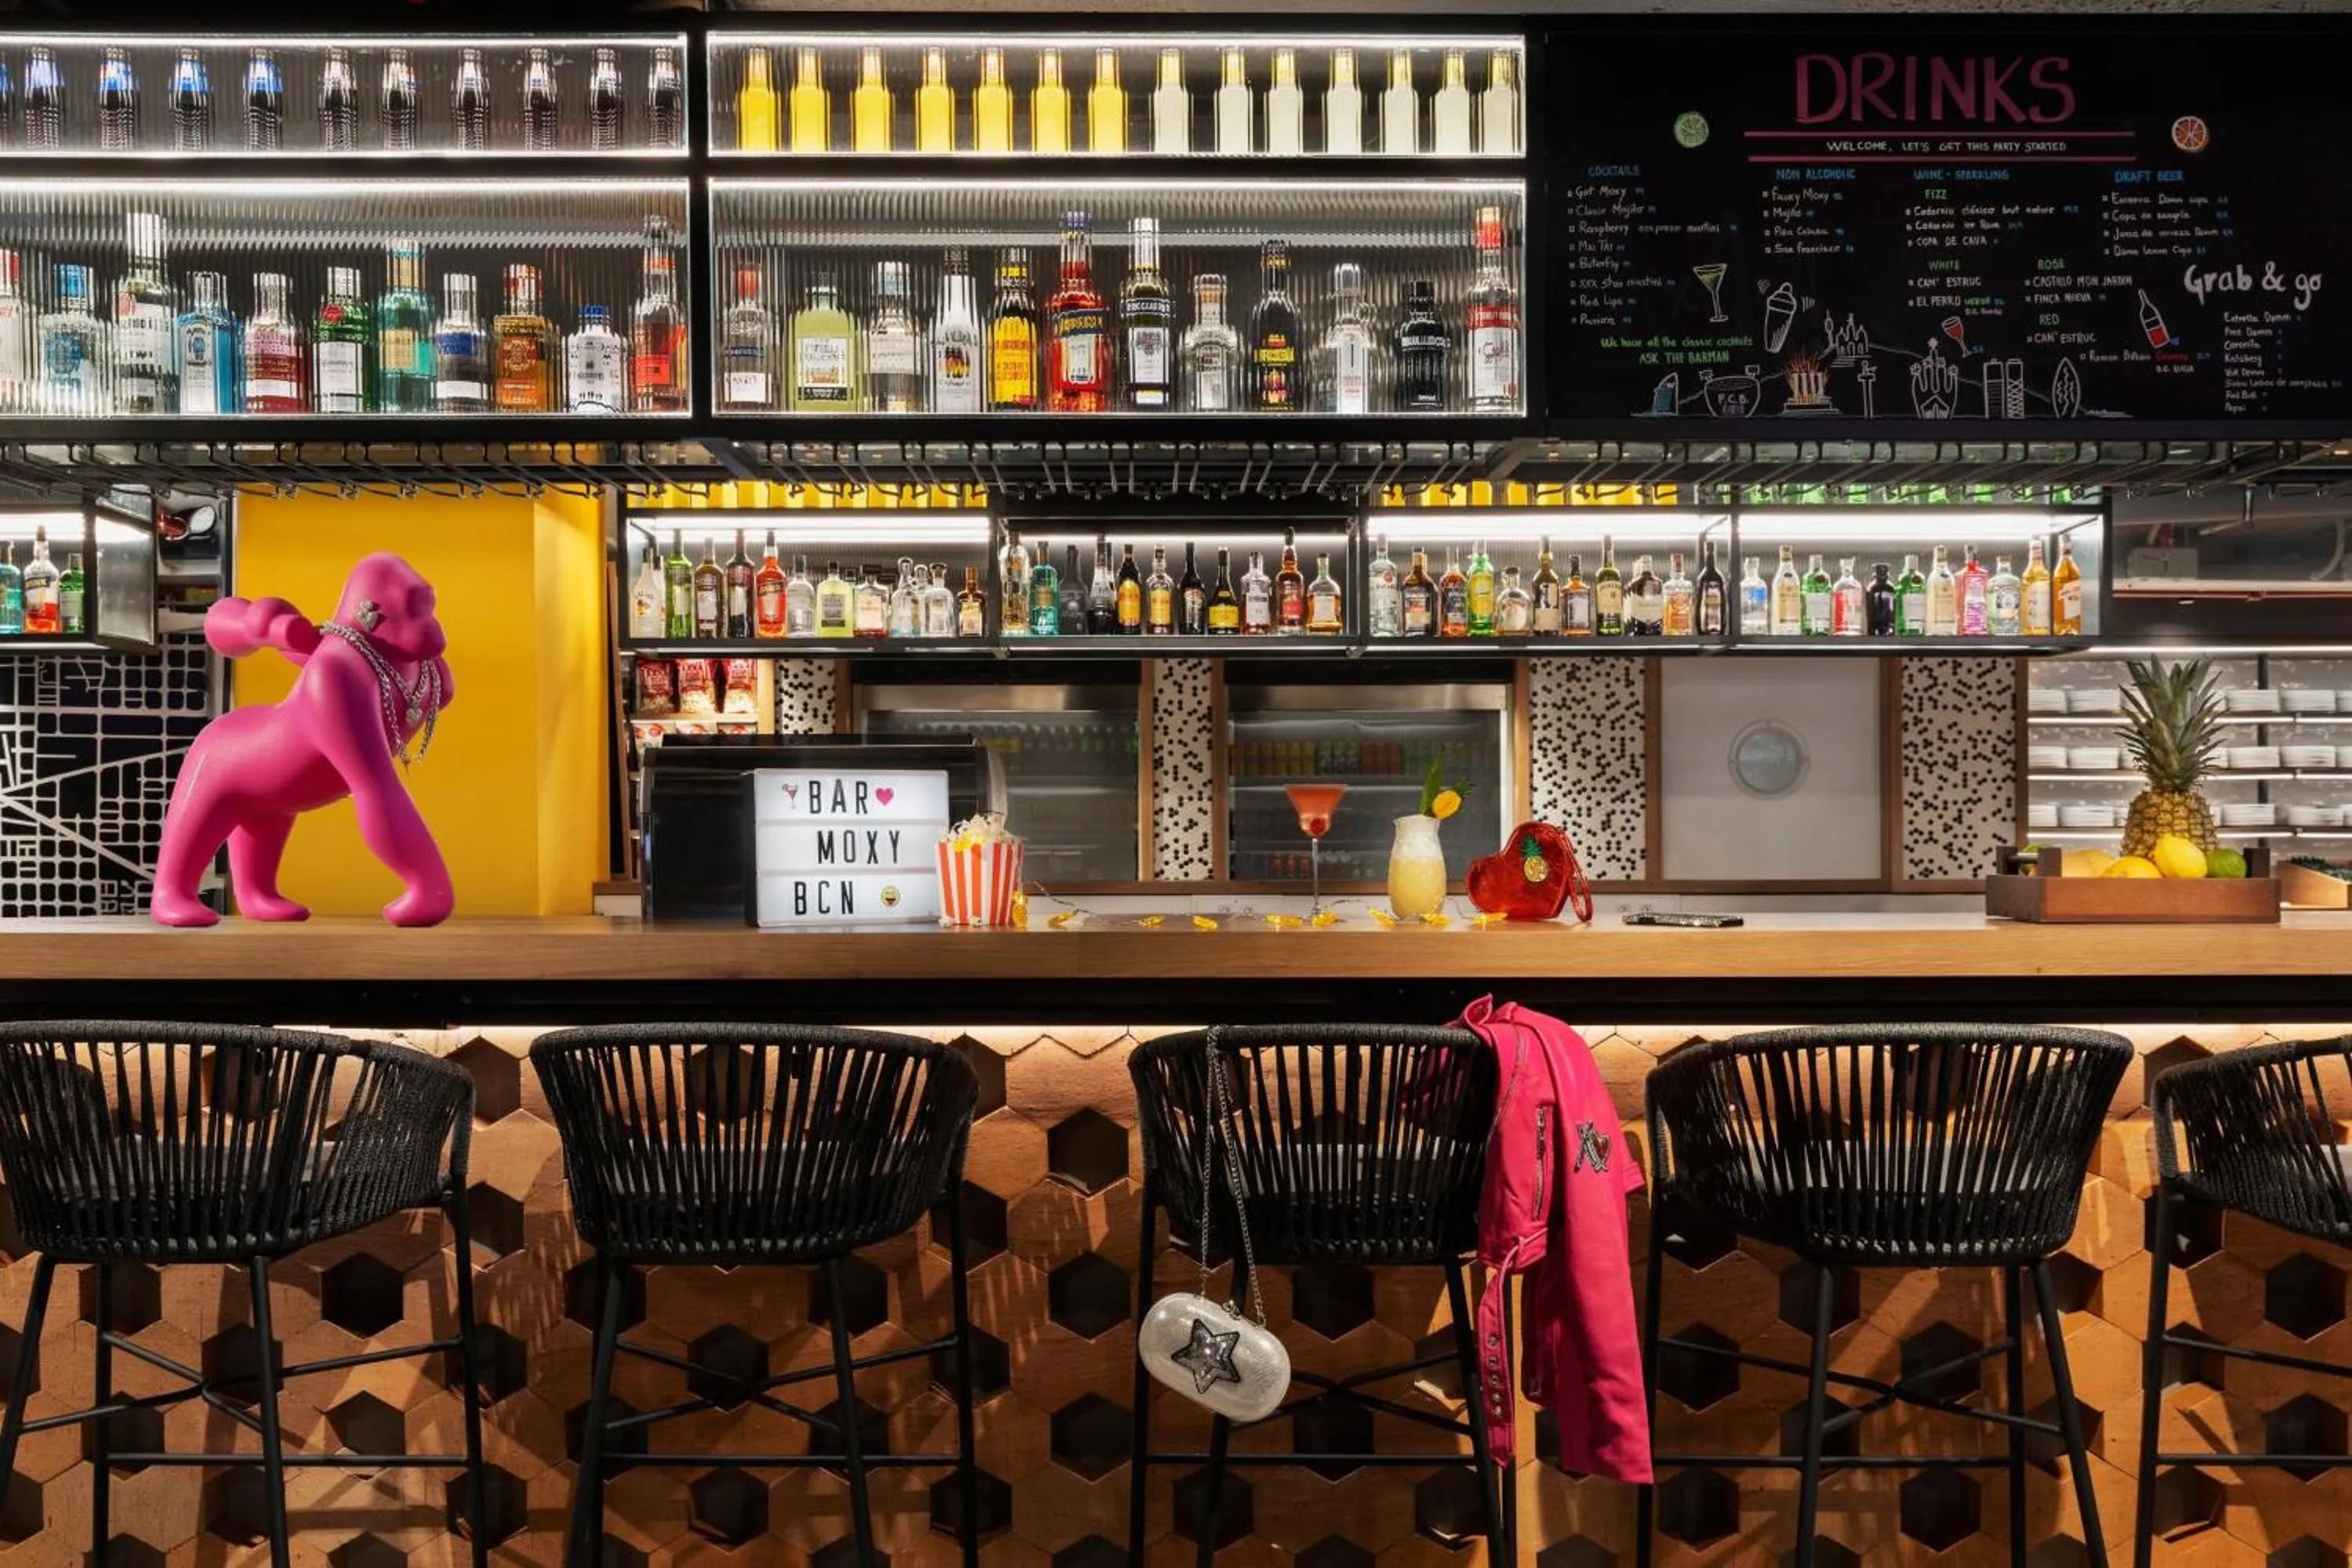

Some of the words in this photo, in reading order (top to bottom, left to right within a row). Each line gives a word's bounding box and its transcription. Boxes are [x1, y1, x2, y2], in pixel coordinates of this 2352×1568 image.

[1795, 50, 2076, 124] DRINKS
[1828, 141, 1892, 152] WELCOME,
[1903, 141, 1929, 152] LET'S
[1940, 141, 1960, 151] GET
[1966, 141, 1989, 151] THIS
[1993, 141, 2020, 151] PARTY
[2024, 141, 2065, 152] STARTED
[1806, 169, 1856, 180] ALCOHOLIC
[1915, 169, 1944, 180] WINE
[2114, 170, 2151, 183] DRAFT
[1926, 189, 1947, 199] FIZZ
[1944, 236, 1958, 247] DE
[1930, 260, 1959, 270] WHITE
[2183, 263, 2254, 307] Grab
[2261, 260, 2288, 292] &
[2293, 272, 2323, 311] go
[1915, 296, 1929, 307] EL
[2040, 314, 2060, 326] RED
[808, 779, 868, 815] BAR
[817, 829, 900, 865] MOXY
[793, 880, 855, 916] BCN
